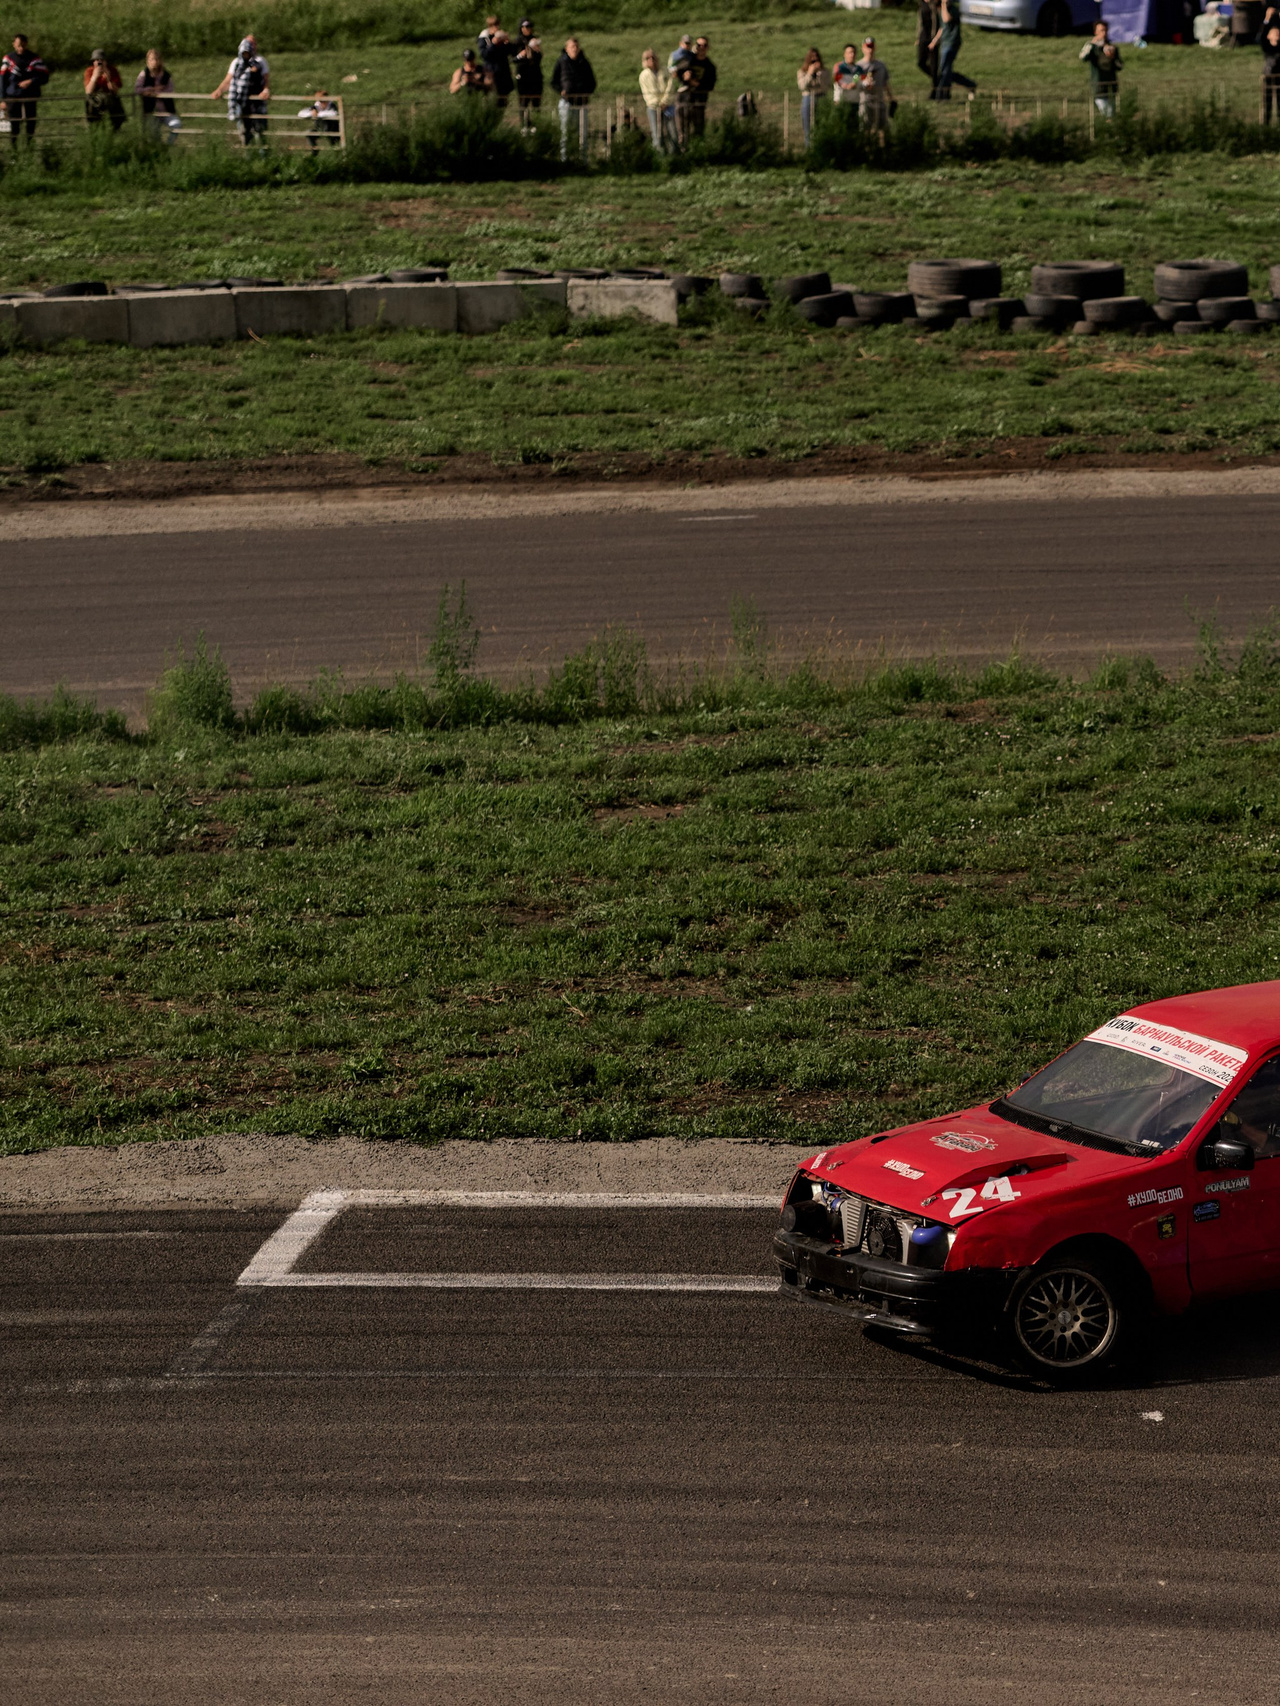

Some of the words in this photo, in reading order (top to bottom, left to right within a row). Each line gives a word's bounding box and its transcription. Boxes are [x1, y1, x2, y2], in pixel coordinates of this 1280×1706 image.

[1106, 1018, 1140, 1032] КУБОК
[1133, 1024, 1210, 1056] БАРНАУЛЬСКОЙ
[1217, 1071, 1236, 1083] 202
[942, 1176, 1021, 1218] 24
[1205, 1177, 1250, 1193] PONULYAM
